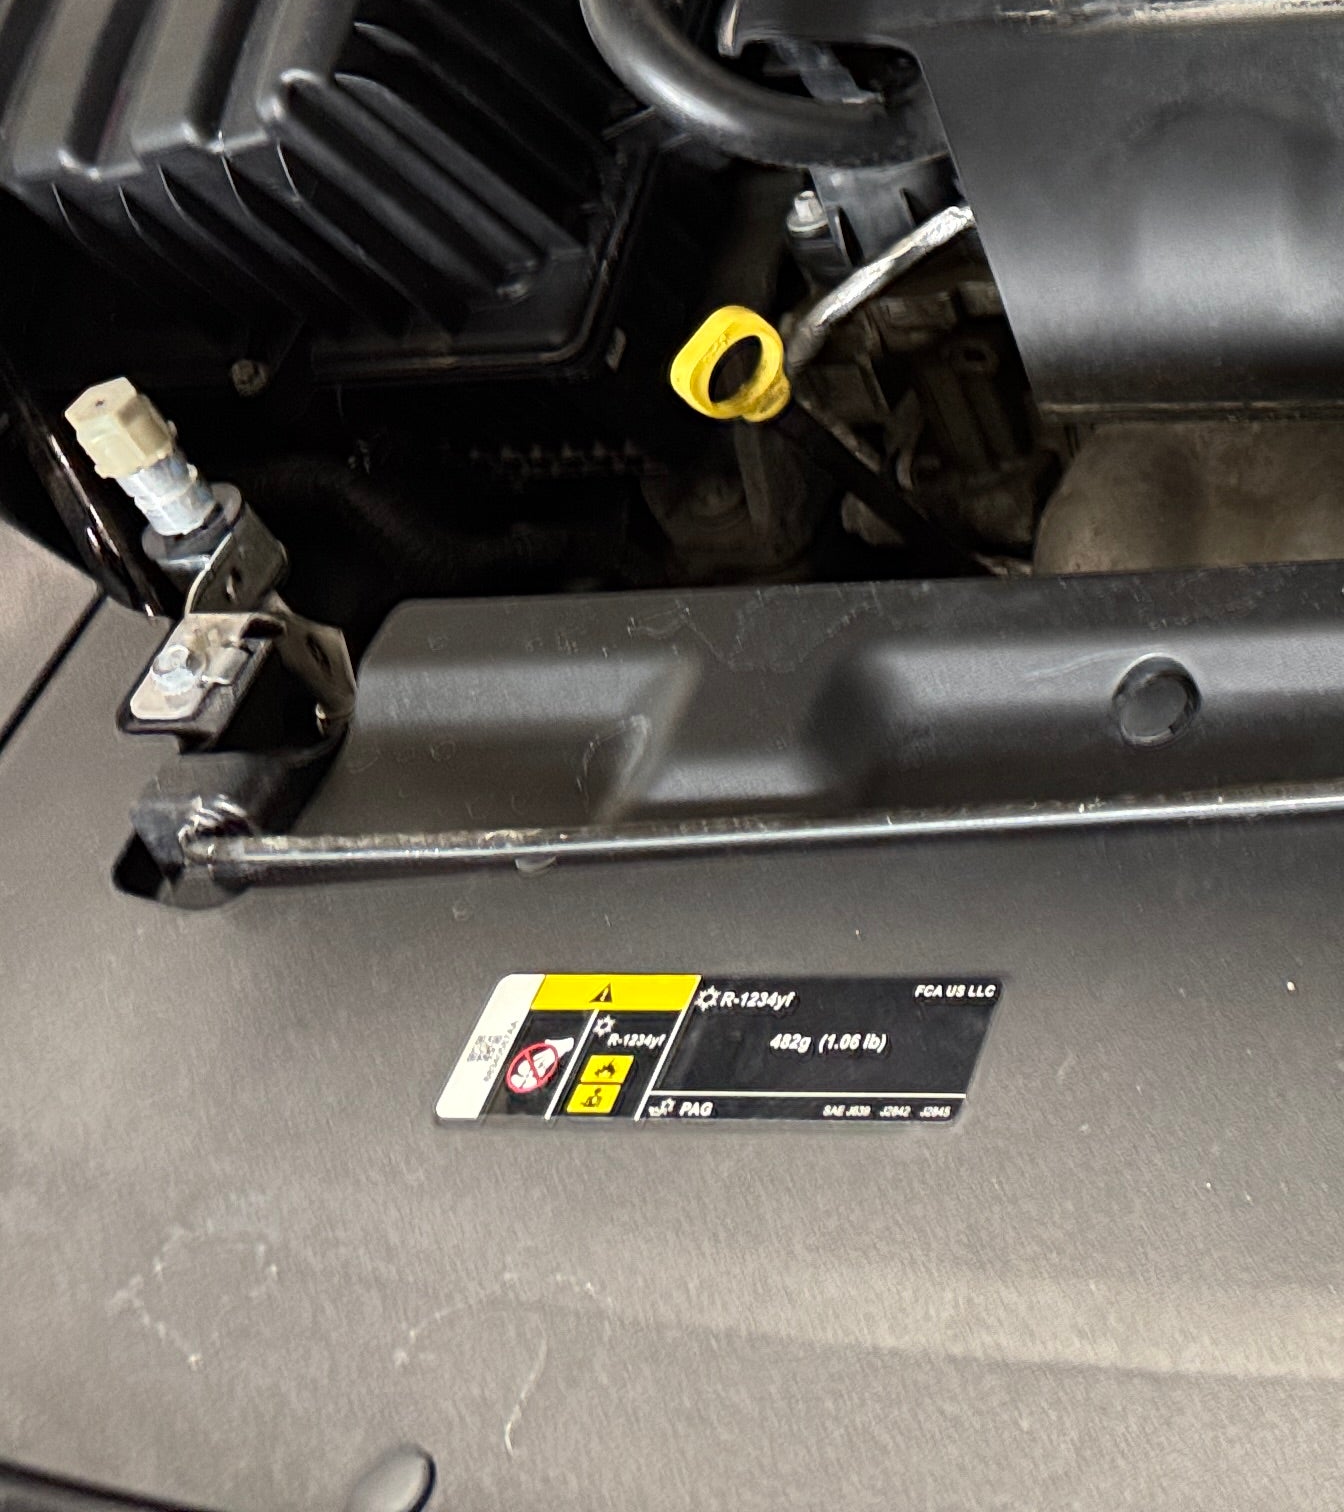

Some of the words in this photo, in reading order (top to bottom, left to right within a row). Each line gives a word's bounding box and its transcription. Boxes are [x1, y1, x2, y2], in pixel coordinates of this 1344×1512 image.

[914, 984, 943, 998] FCA
[945, 984, 967, 998] US
[967, 984, 996, 998] LLC
[719, 991, 796, 1011] R-1234yf
[607, 1032, 667, 1050] R-1234yf
[769, 1033, 812, 1054] 482g
[818, 1033, 862, 1054] (1.06
[862, 1033, 887, 1054] lb)
[679, 1101, 714, 1117] PAG
